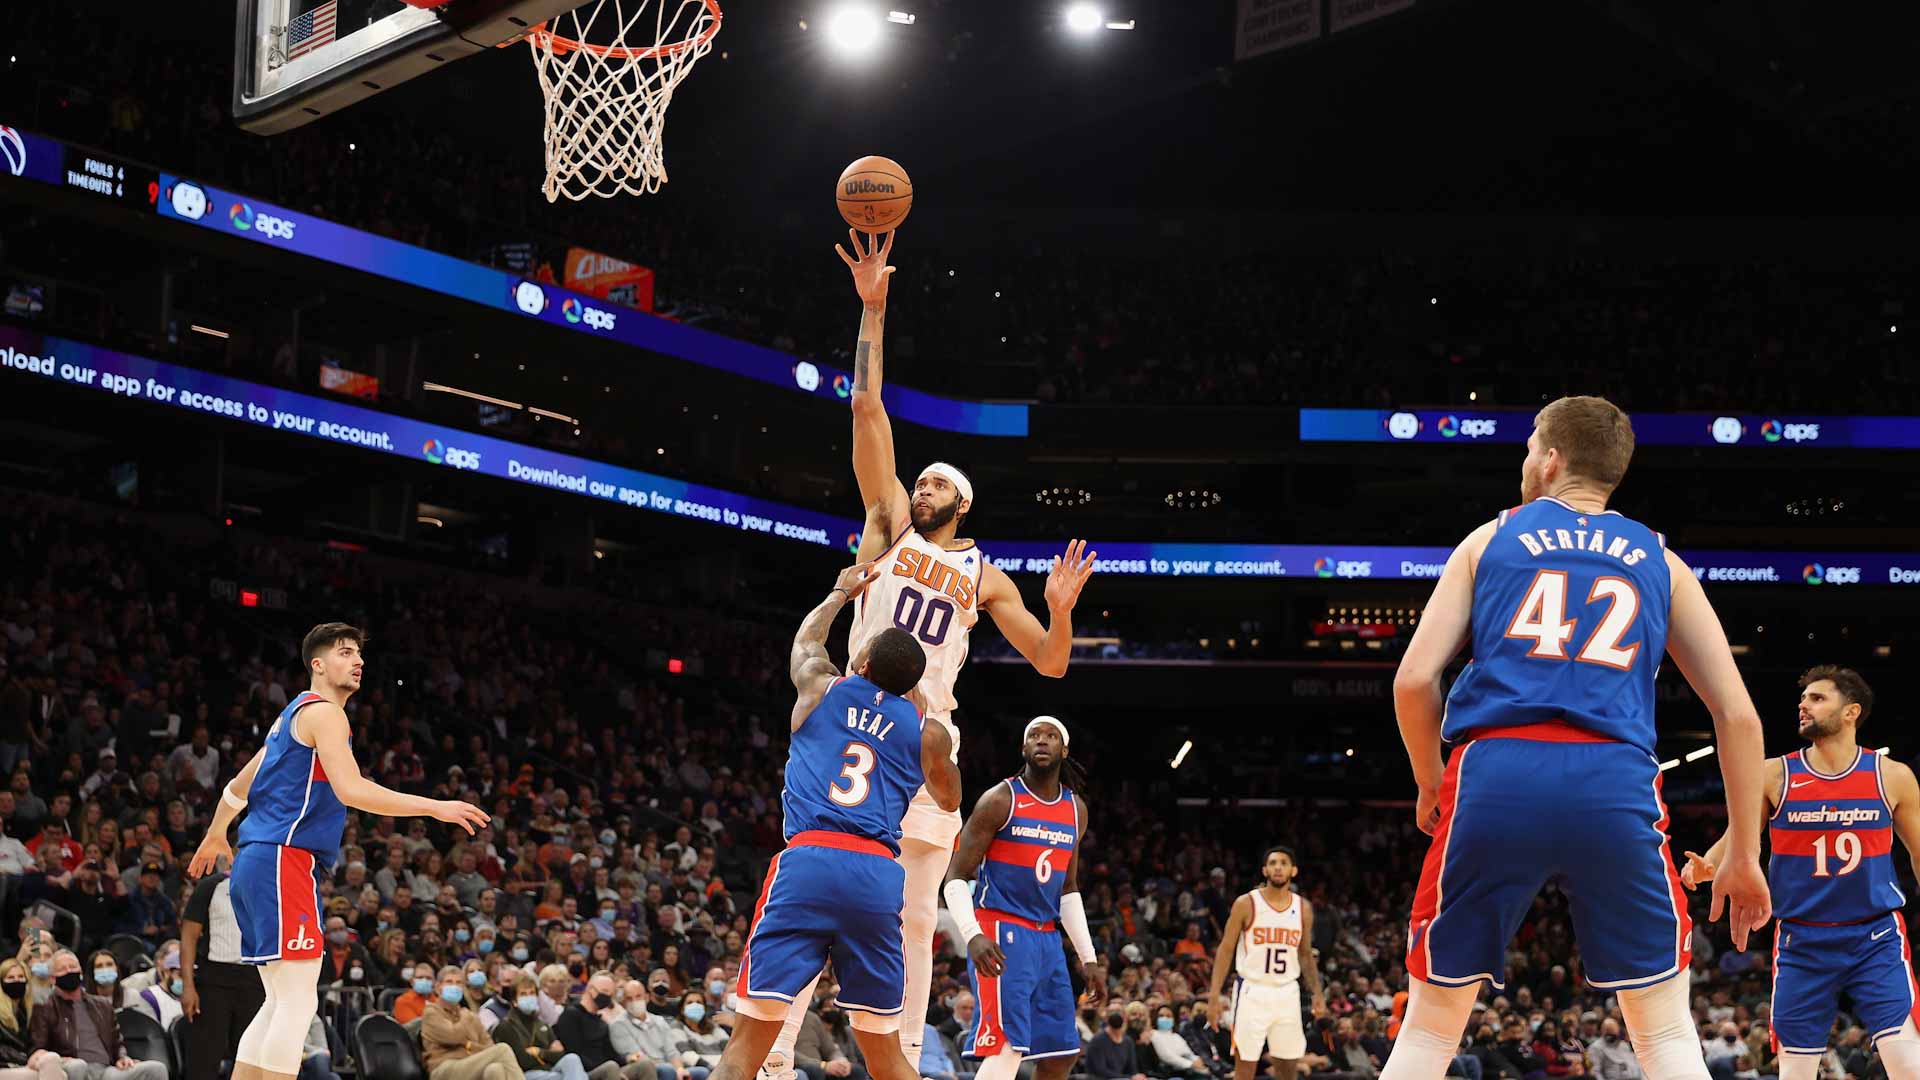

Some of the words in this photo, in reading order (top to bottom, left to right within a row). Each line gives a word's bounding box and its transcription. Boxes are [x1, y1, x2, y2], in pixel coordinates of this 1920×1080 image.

[85, 158, 114, 178] FOULS
[117, 166, 124, 180] 4
[67, 171, 112, 196] TIMEOUTS
[116, 181, 123, 197] 4
[845, 179, 895, 195] Wilson
[255, 212, 296, 240] aps
[583, 307, 616, 330] aps
[60, 362, 98, 385] our
[101, 372, 141, 397] app
[146, 378, 176, 402] for
[179, 390, 244, 418] access
[248, 402, 269, 423] to
[272, 411, 315, 429] your
[318, 420, 394, 451] account.
[1460, 418, 1497, 439] aps
[1783, 423, 1820, 443] aps
[445, 446, 481, 470] aps
[508, 459, 588, 493] Download
[589, 479, 615, 499] our
[618, 487, 648, 507] app
[650, 491, 673, 511] for
[674, 498, 722, 523] access
[723, 507, 739, 525] to
[741, 513, 774, 531] your
[773, 521, 831, 546] account.
[993, 558, 1024, 572] our
[1092, 558, 1146, 574] access
[1150, 556, 1169, 574] to
[1172, 559, 1213, 577] your
[1213, 558, 1287, 575] account.
[1335, 561, 1372, 579] aps
[1708, 565, 1780, 582] account.
[1825, 567, 1861, 585] aps
[893, 586, 954, 646] 00
[1504, 568, 1642, 672] 42
[847, 706, 895, 742] BEAL
[828, 741, 877, 807] 3
[1787, 804, 1880, 826] washington
[1011, 823, 1073, 845] washington
[1035, 848, 1054, 883] 6
[1811, 831, 1863, 877] 19
[1265, 948, 1287, 974] 15
